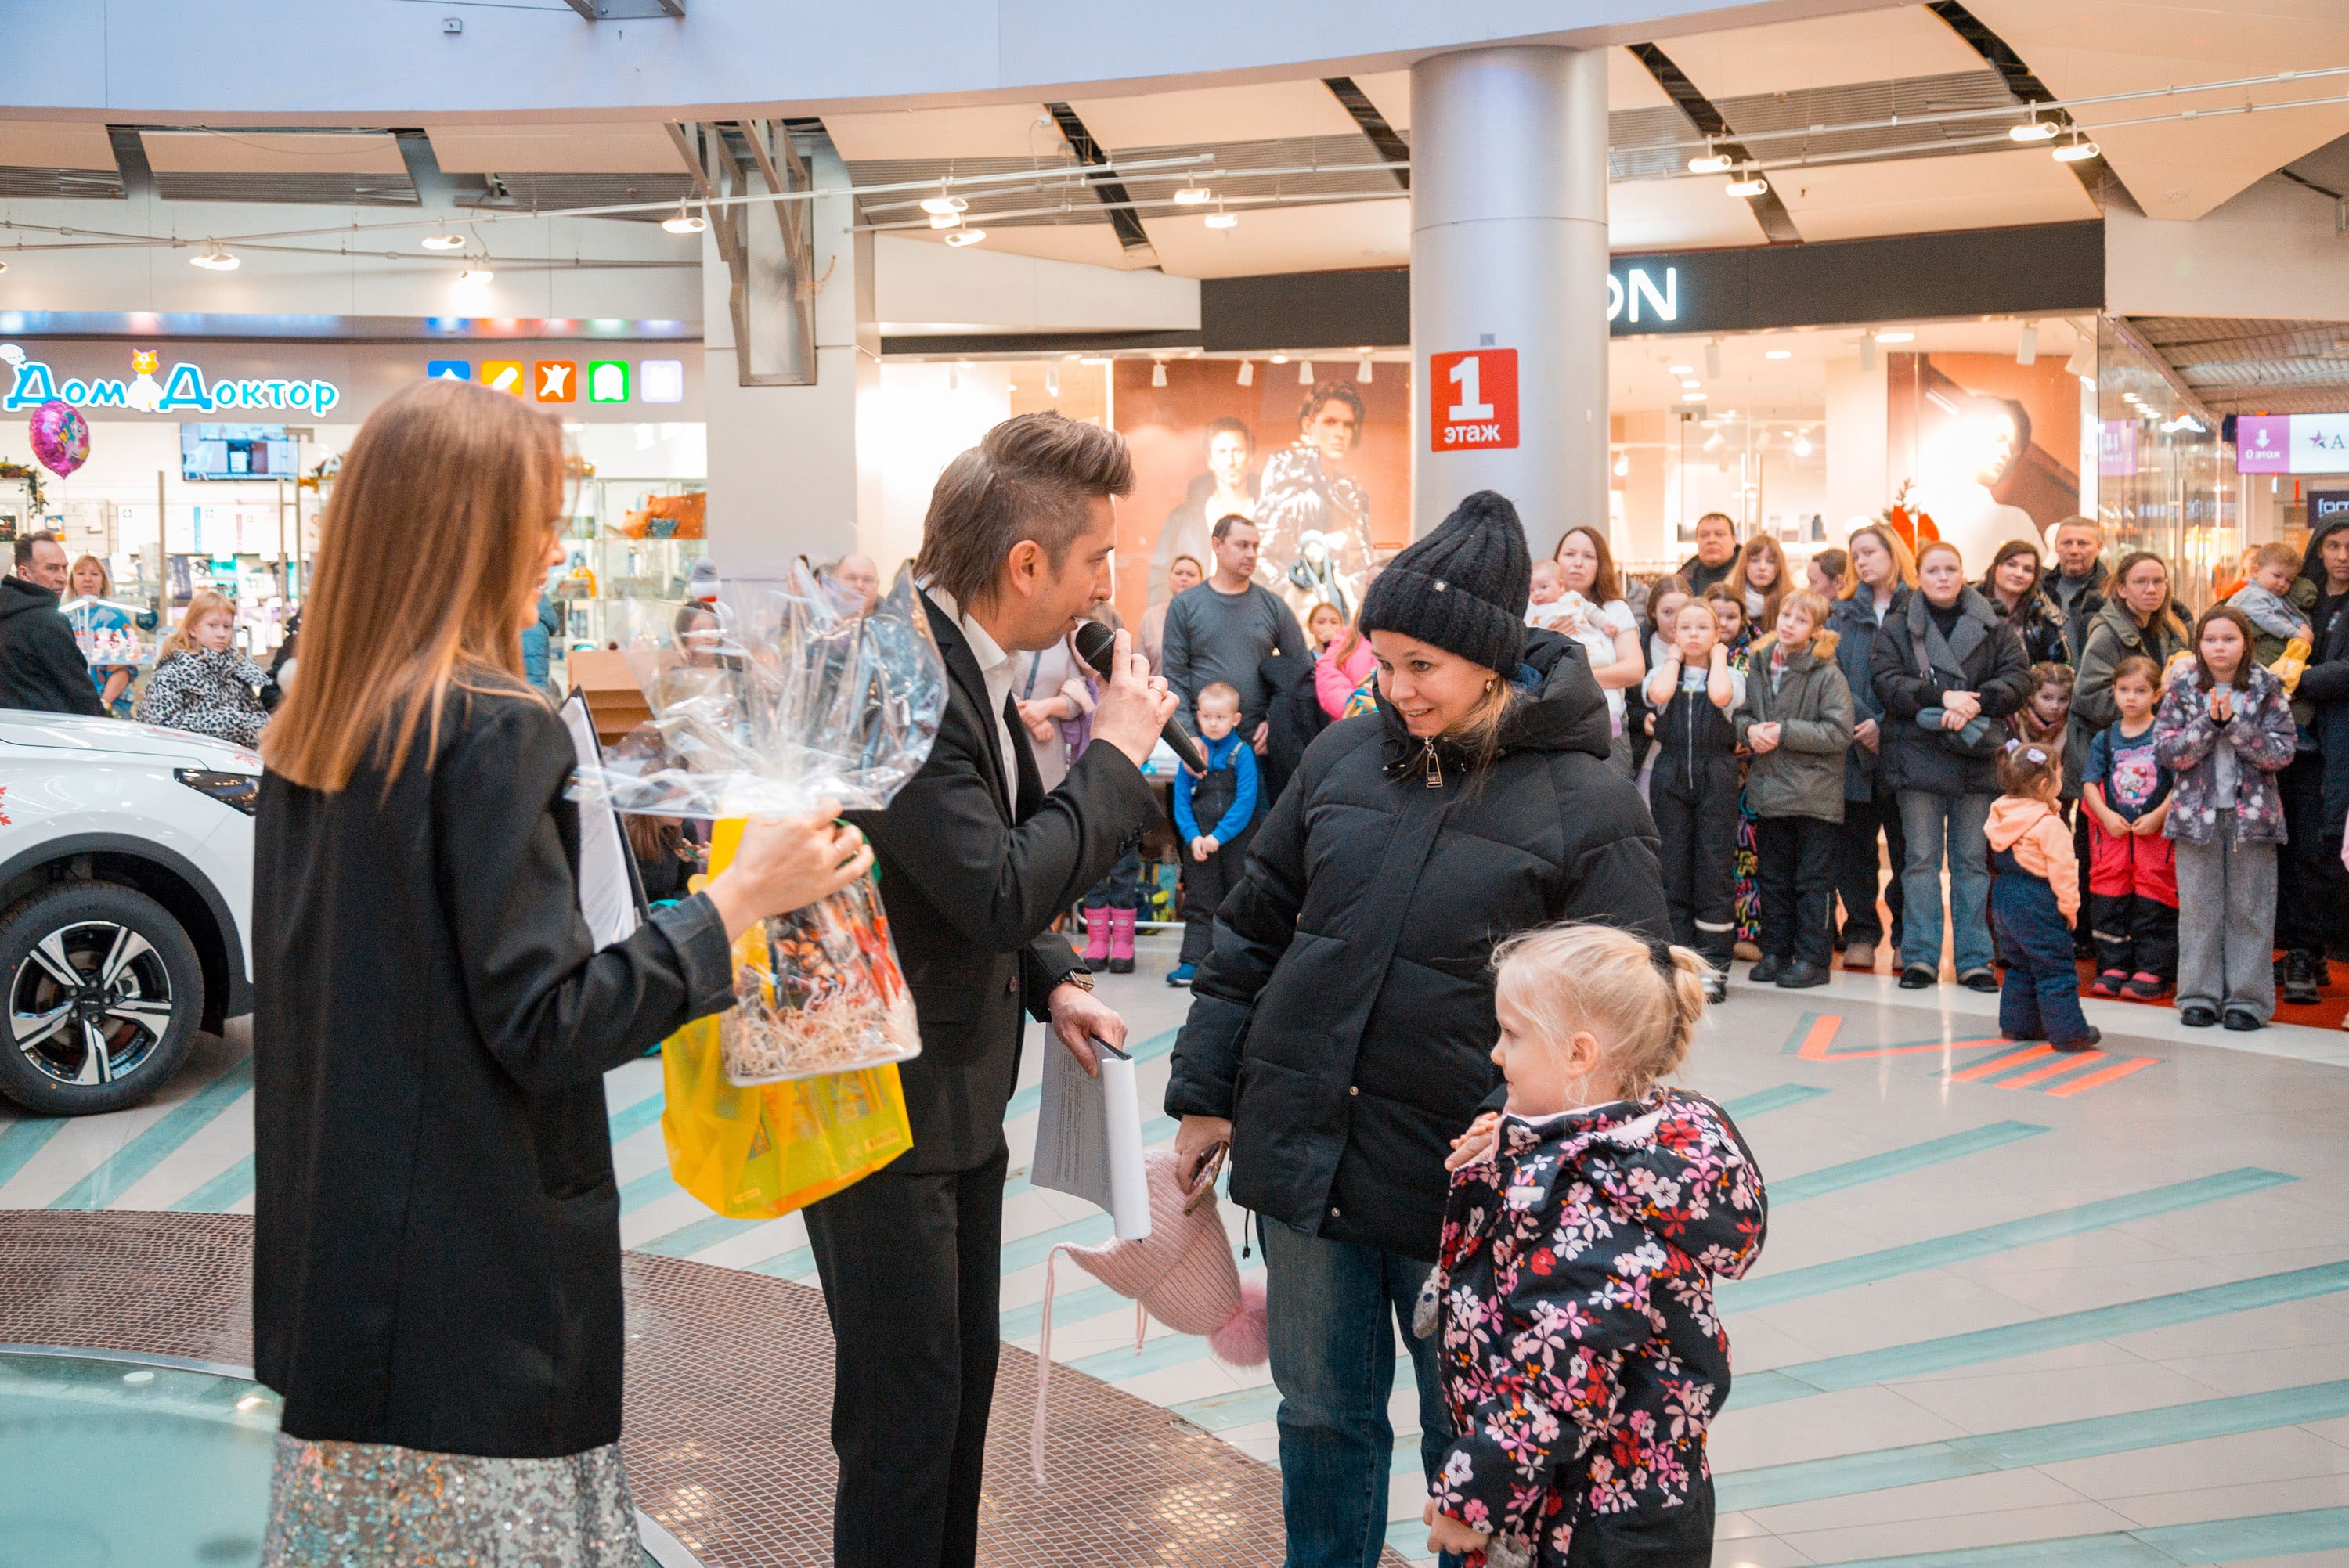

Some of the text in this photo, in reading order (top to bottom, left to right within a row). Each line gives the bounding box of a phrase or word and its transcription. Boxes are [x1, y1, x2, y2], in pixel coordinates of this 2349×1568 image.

[5, 363, 339, 417] Дом Доктор
[1449, 356, 1494, 420] 1
[1444, 424, 1501, 444] этаж
